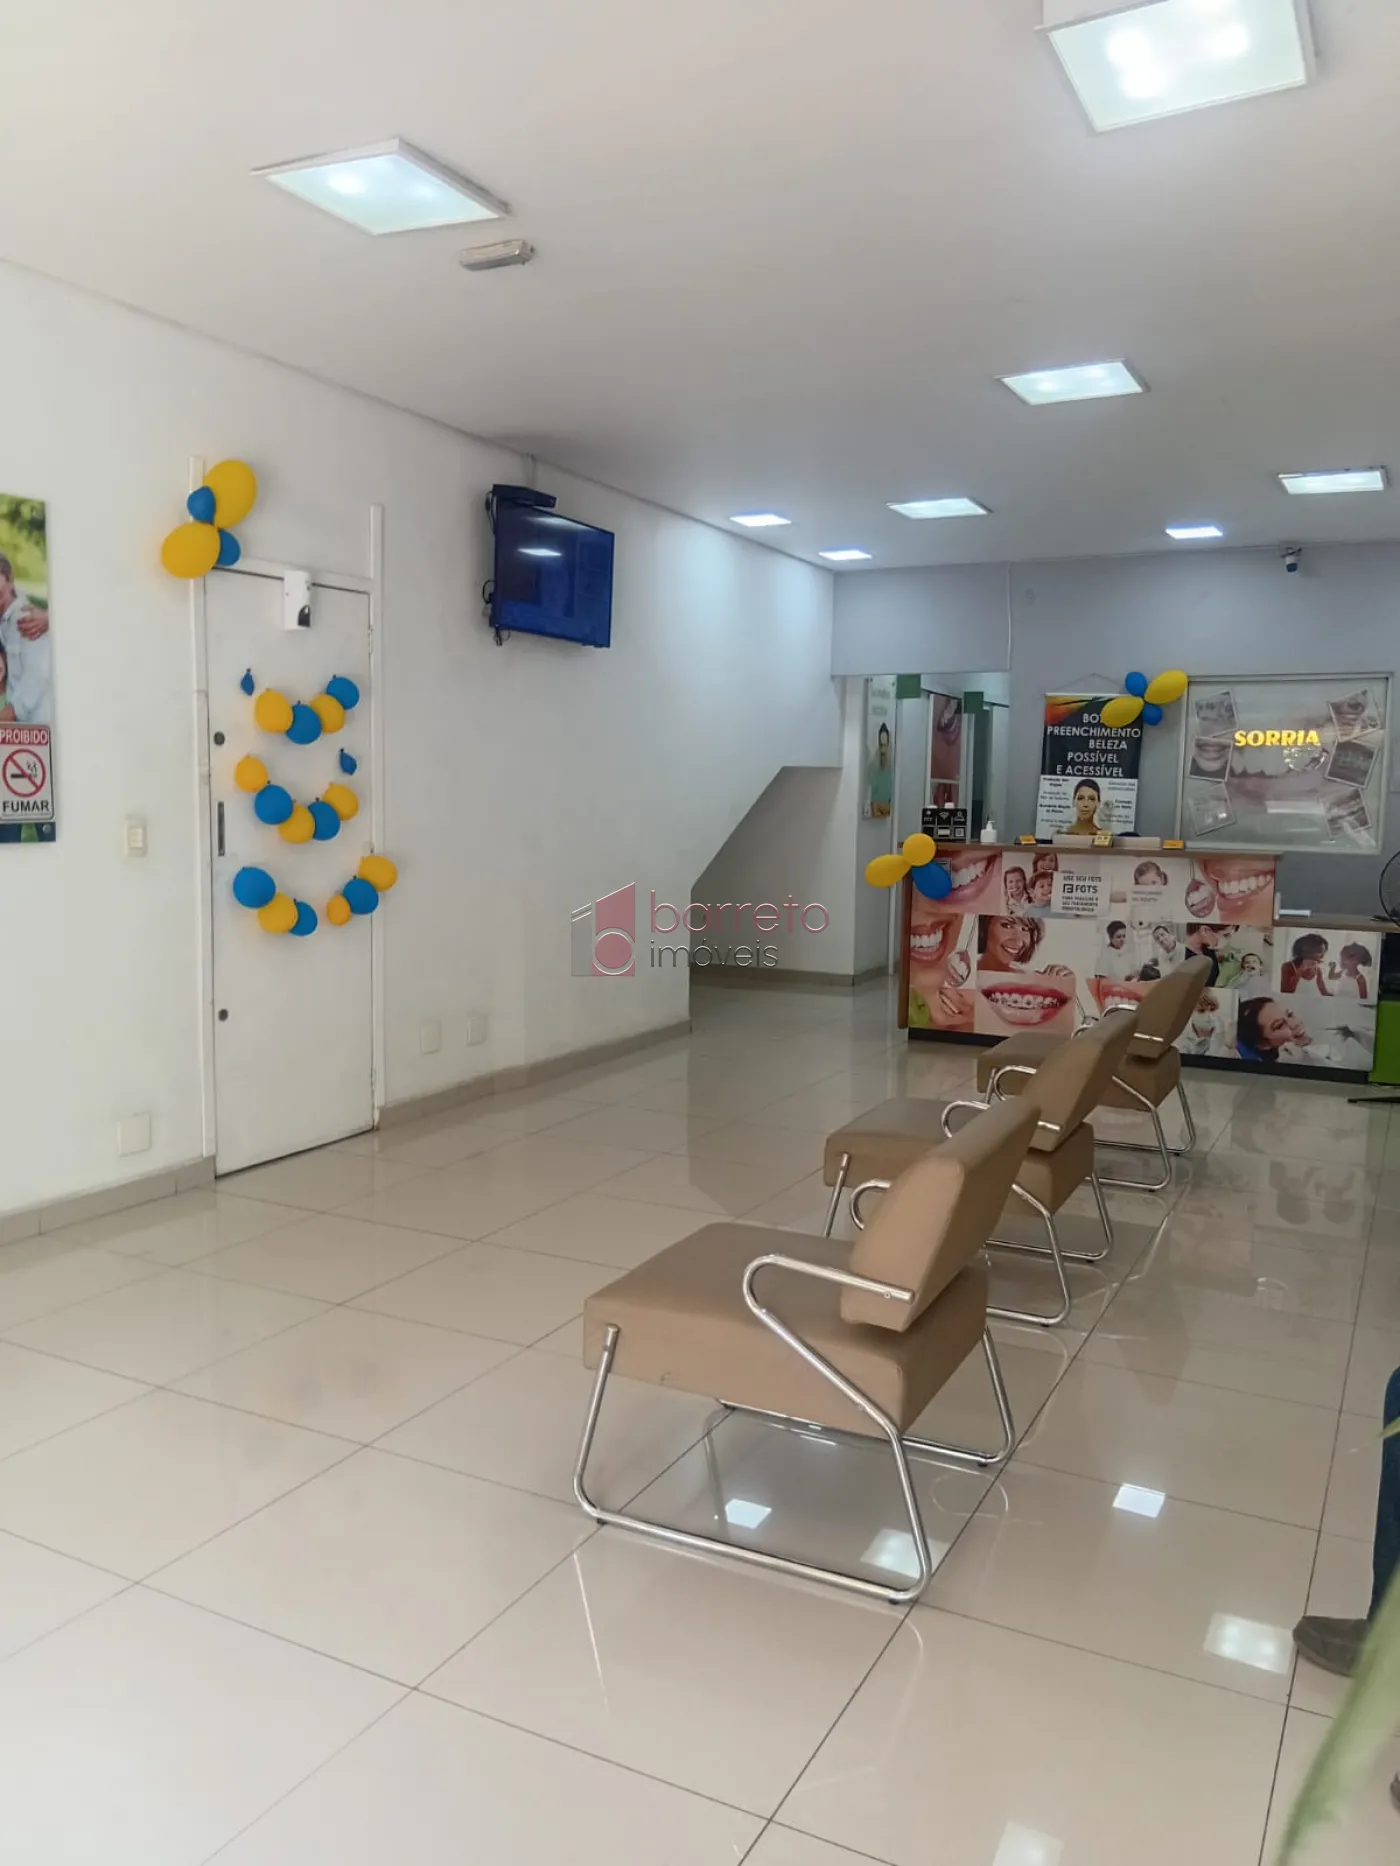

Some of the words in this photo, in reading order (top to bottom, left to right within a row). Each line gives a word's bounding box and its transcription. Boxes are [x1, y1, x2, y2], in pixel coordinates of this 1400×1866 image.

[0, 729, 48, 744] PROIBIDO
[1047, 727, 1141, 738] PREENCHIMENTO
[1233, 729, 1321, 747] SORRIA
[1088, 740, 1128, 750] BELEZA
[1067, 751, 1119, 764] POSSÍVEL
[1056, 765, 1062, 775] E
[1065, 765, 1124, 777] ACESSÍVEL
[2, 801, 49, 812] FUMAR
[1075, 884, 1098, 894] FGTS
